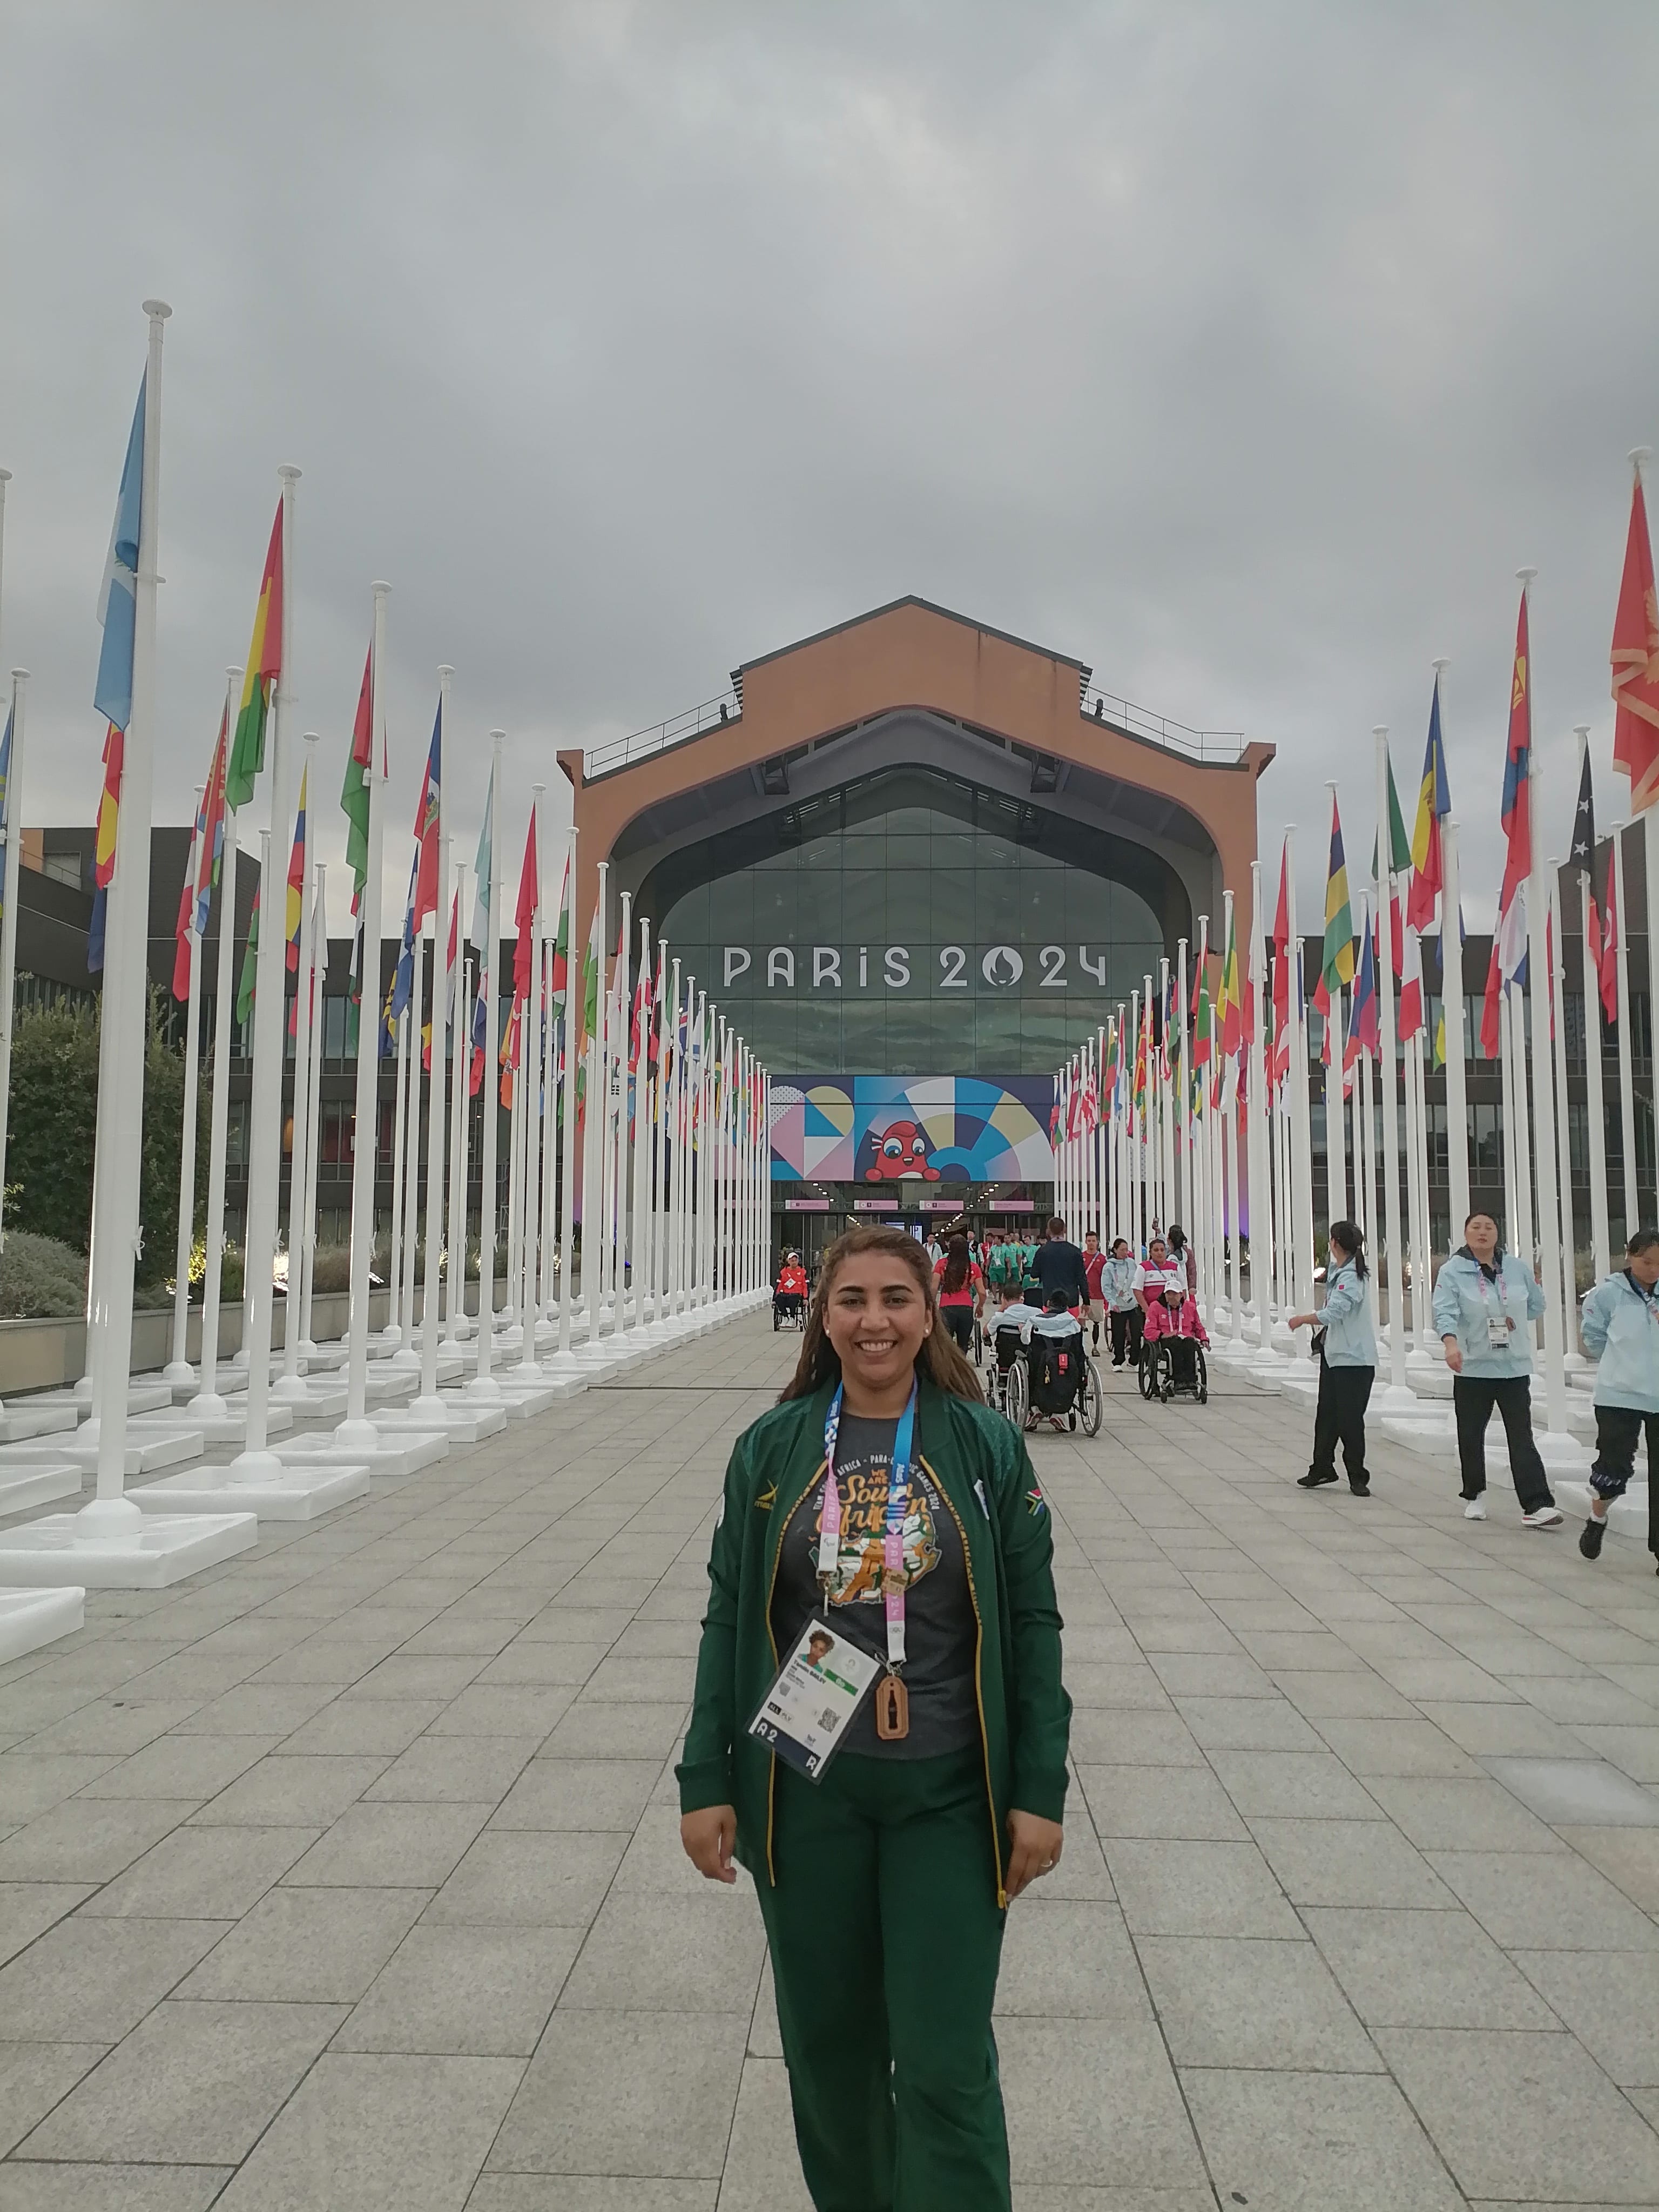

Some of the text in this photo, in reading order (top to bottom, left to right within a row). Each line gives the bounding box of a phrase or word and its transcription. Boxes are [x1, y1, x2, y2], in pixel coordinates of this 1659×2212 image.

[939, 946, 1107, 987] 2024
[837, 1459, 861, 1476] AFRICA
[916, 1471, 935, 1493] GAMES
[867, 1475, 889, 1485] ARE
[871, 1468, 887, 1476] WE
